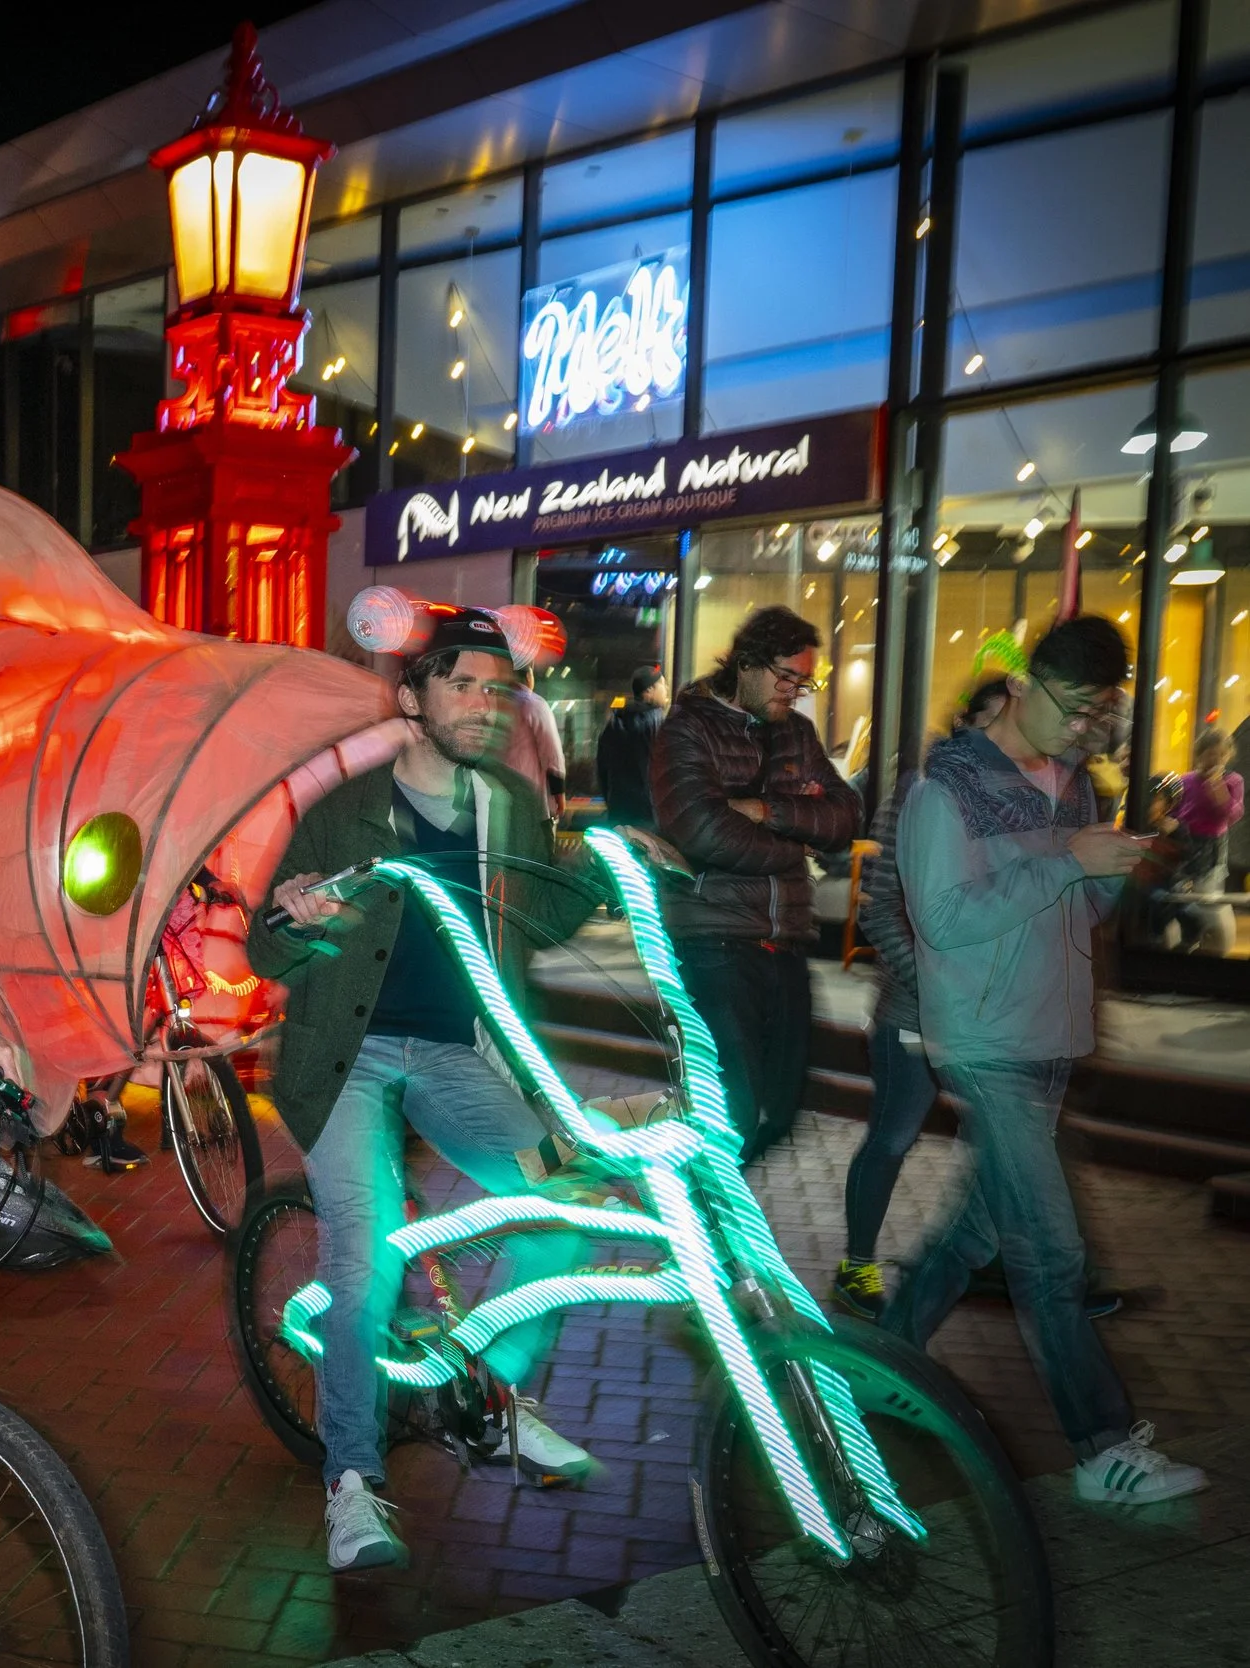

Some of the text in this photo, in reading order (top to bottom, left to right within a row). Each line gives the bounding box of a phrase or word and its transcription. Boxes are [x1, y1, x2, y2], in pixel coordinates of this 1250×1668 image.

[470, 435, 809, 525] New Zealand Natural
[534, 488, 738, 531] PREMIUM ICE CREAM BOUTIQUE
